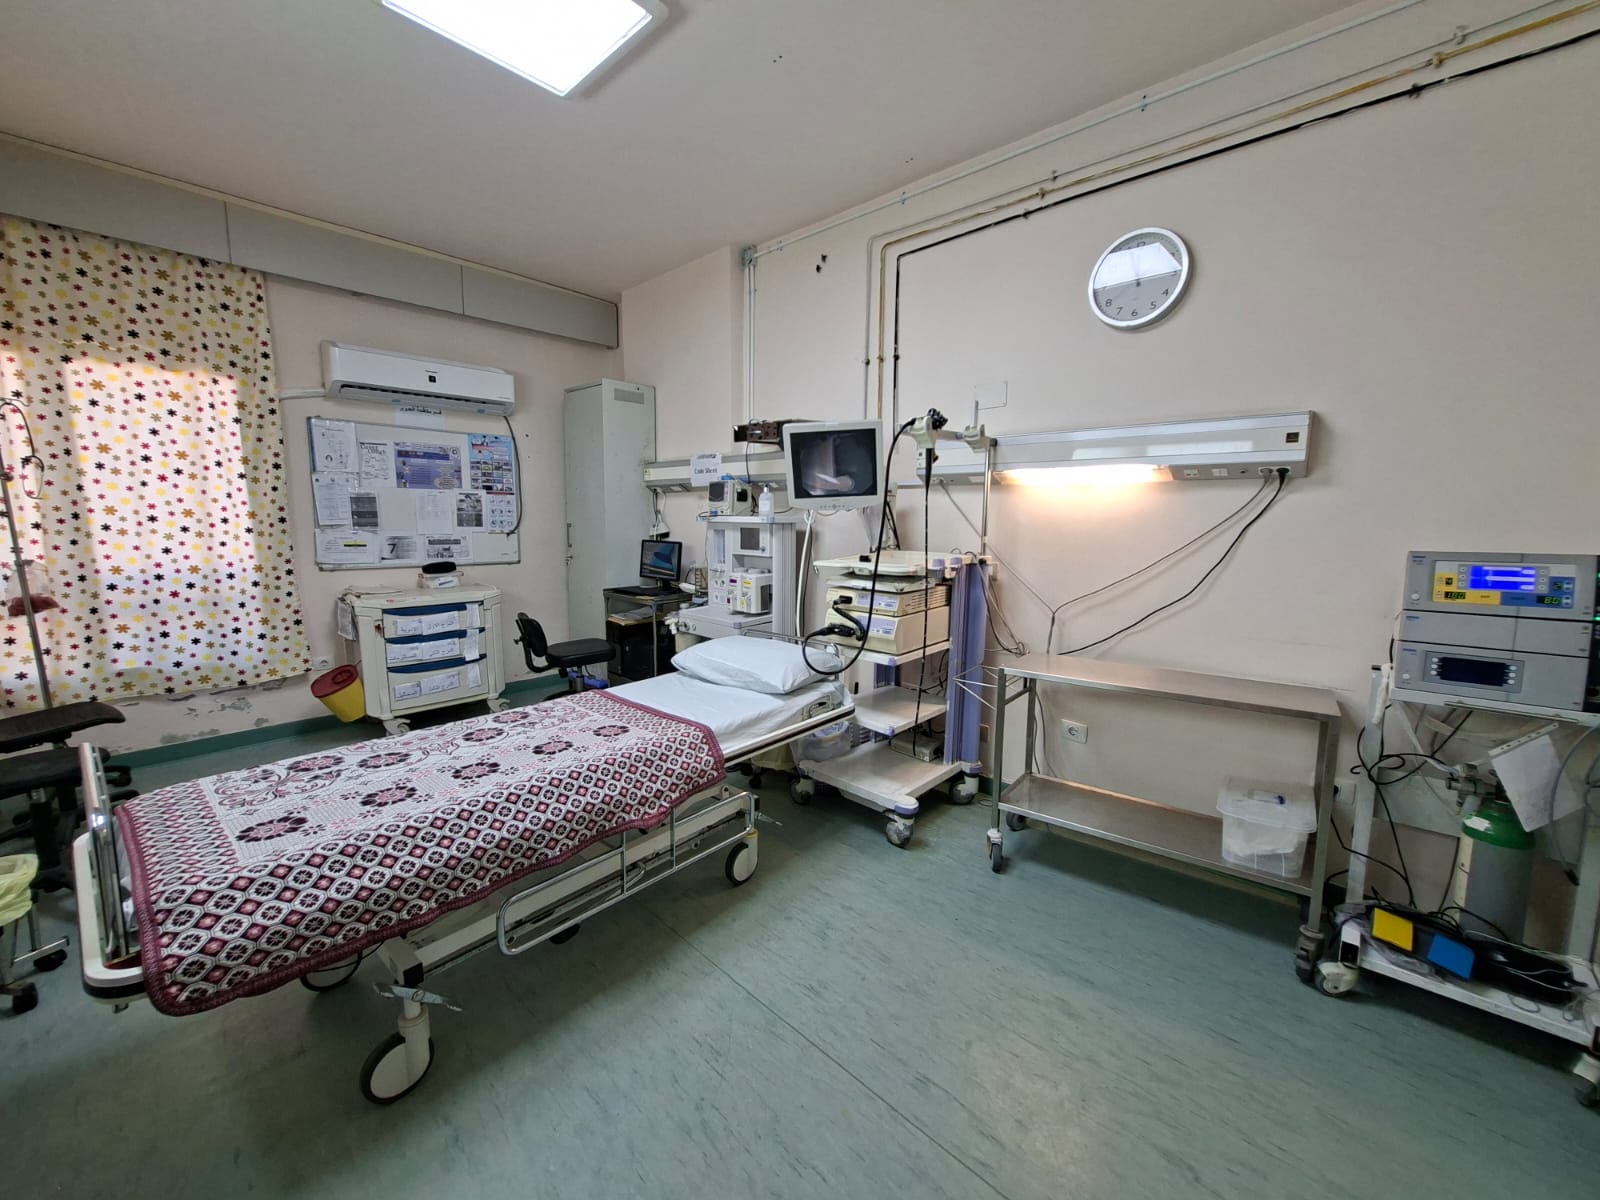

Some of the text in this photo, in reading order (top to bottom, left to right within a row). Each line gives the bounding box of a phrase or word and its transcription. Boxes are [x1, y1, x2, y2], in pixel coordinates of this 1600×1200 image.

[1161, 288, 1169, 297] 4
[1105, 299, 1112, 307] 8
[1149, 301, 1157, 310] 5
[1115, 306, 1123, 316] 7
[1131, 308, 1138, 316] 6
[387, 543, 397, 554] 7
